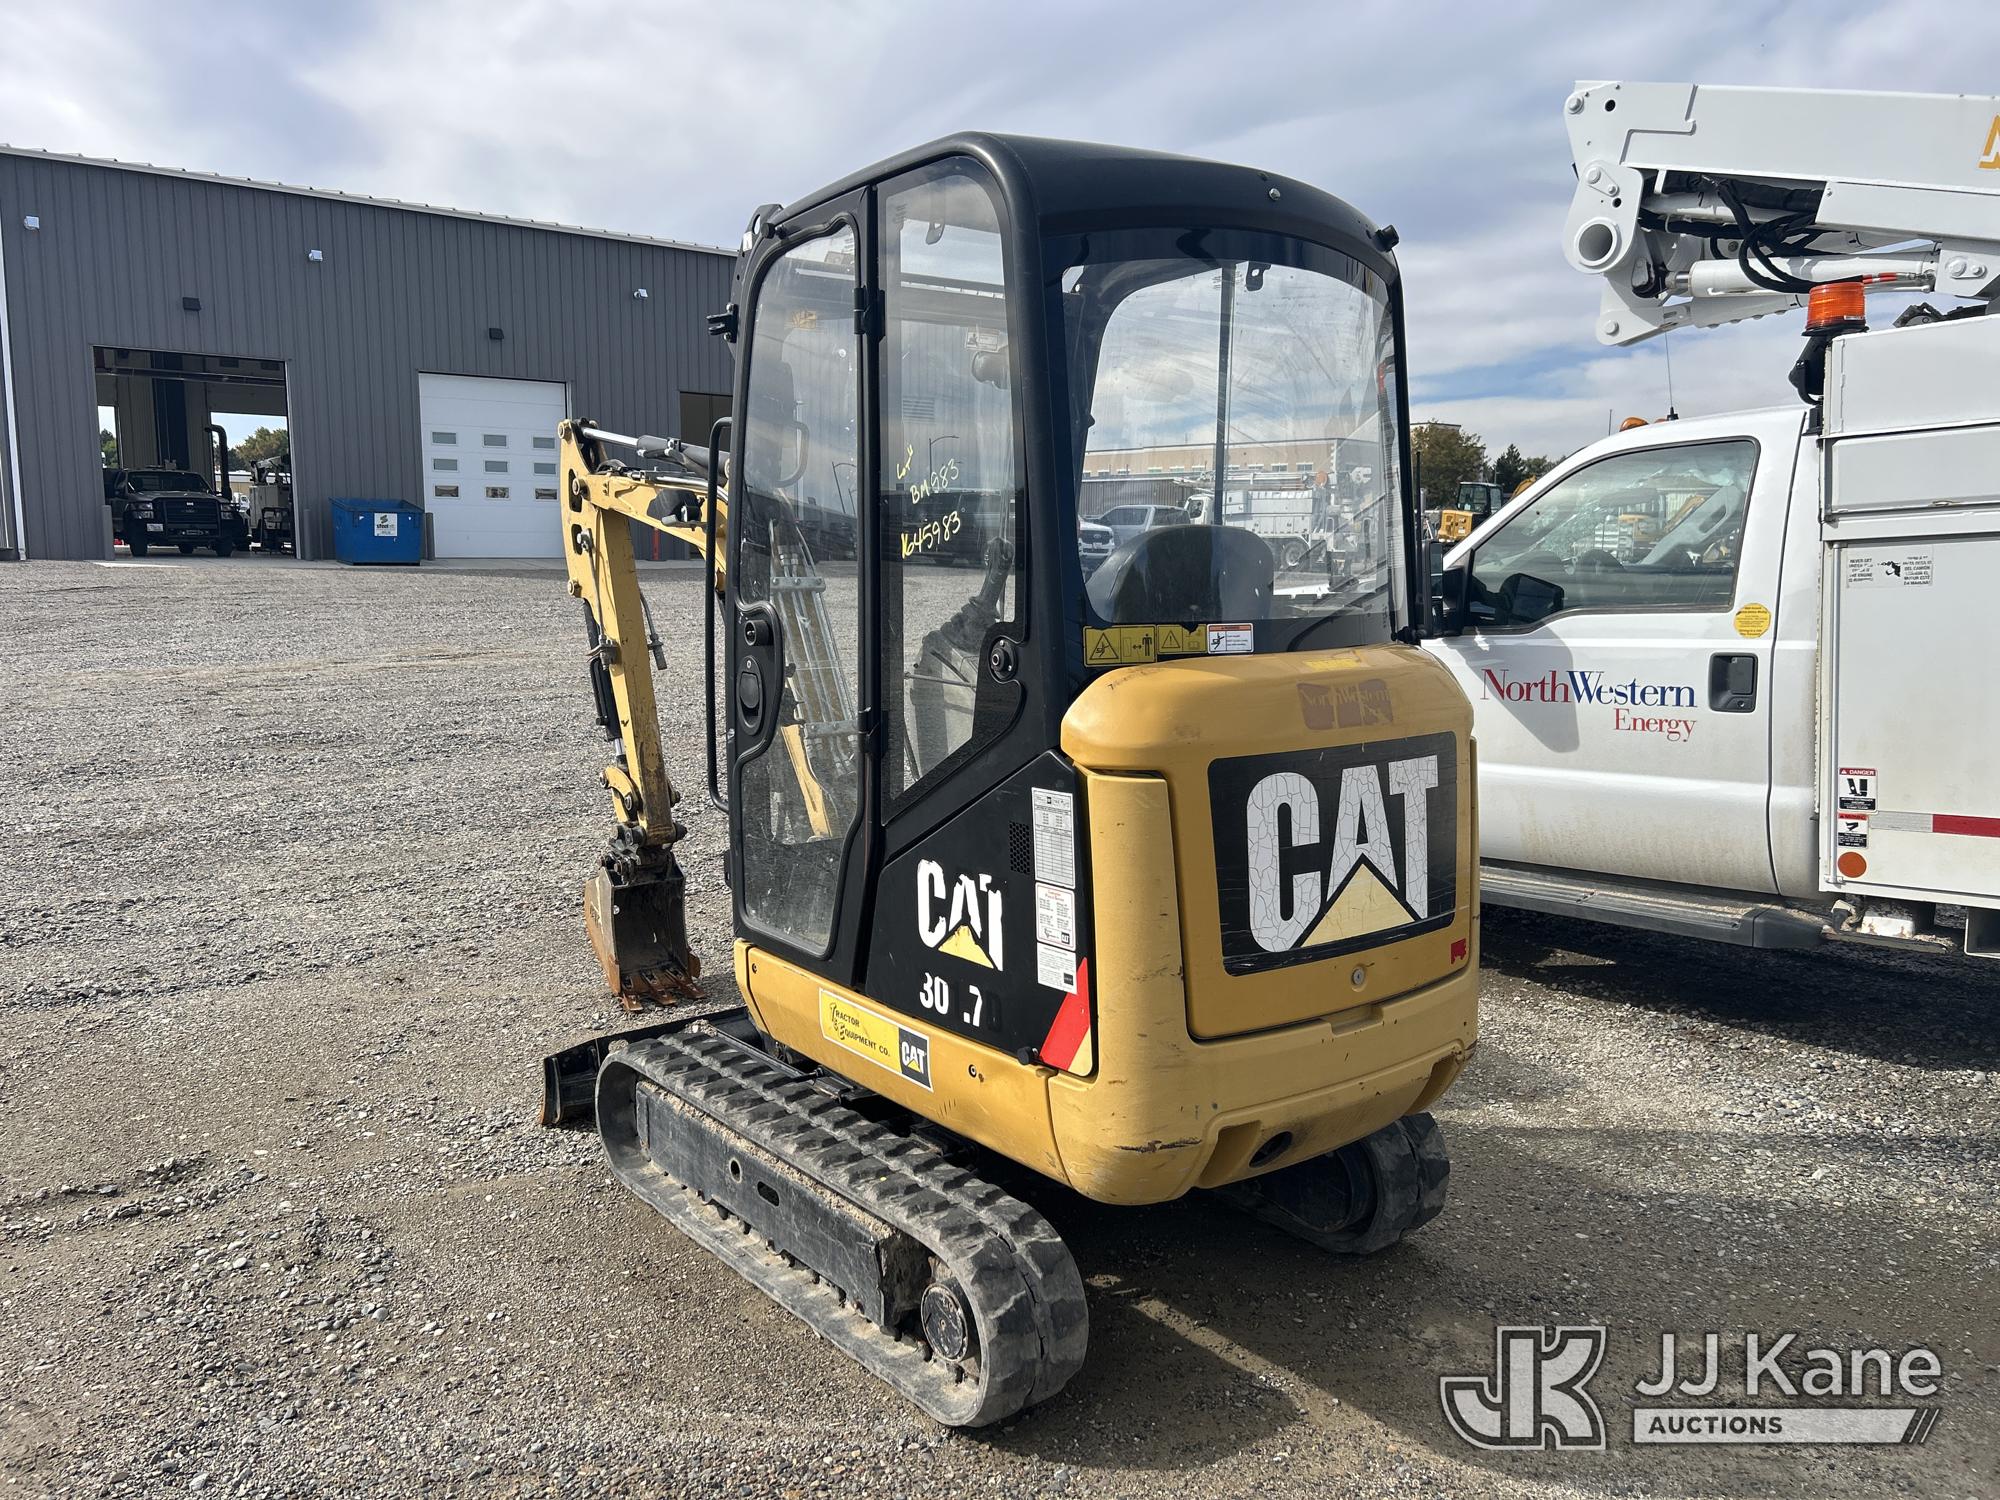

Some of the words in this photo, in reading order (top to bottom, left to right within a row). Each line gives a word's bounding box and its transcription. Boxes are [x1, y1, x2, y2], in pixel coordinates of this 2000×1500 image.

[1480, 668, 1698, 708] NorthWestern
[1613, 708, 1697, 742] Energy
[1247, 755, 1439, 953] CAT
[917, 859, 1003, 971] CAT
[830, 1002, 860, 1028] TRACTOR
[839, 1022, 877, 1051] EQUIPMENT
[901, 1041, 925, 1074] CAT
